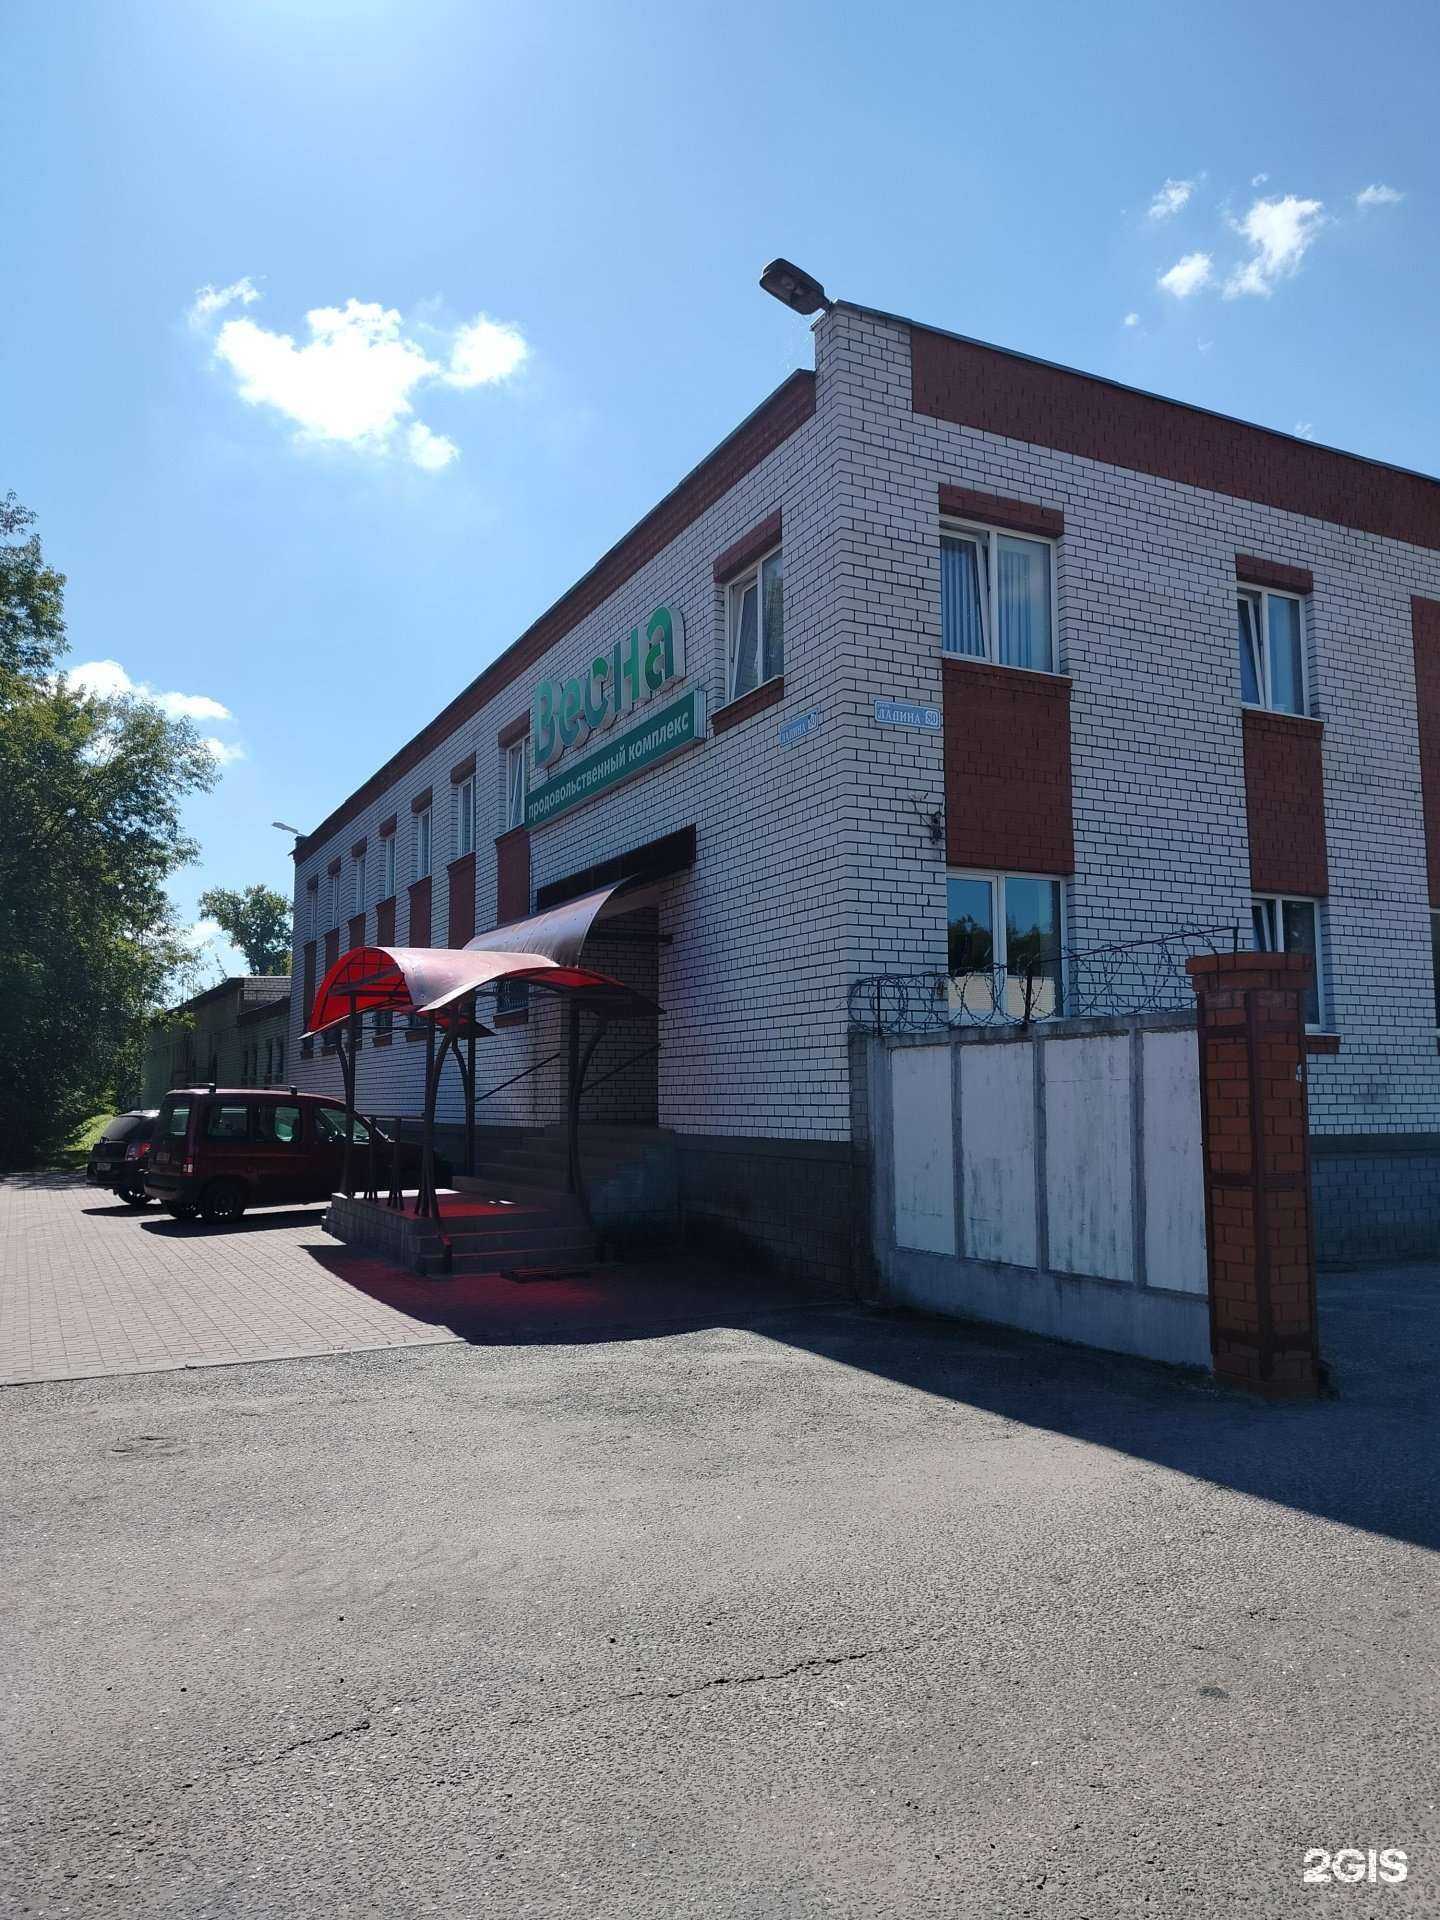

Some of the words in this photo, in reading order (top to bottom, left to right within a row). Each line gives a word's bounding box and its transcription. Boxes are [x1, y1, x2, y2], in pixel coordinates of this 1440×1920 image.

[534, 606, 686, 768] Весна
[528, 746, 627, 820] продовольственный
[628, 712, 689, 764] комплекс
